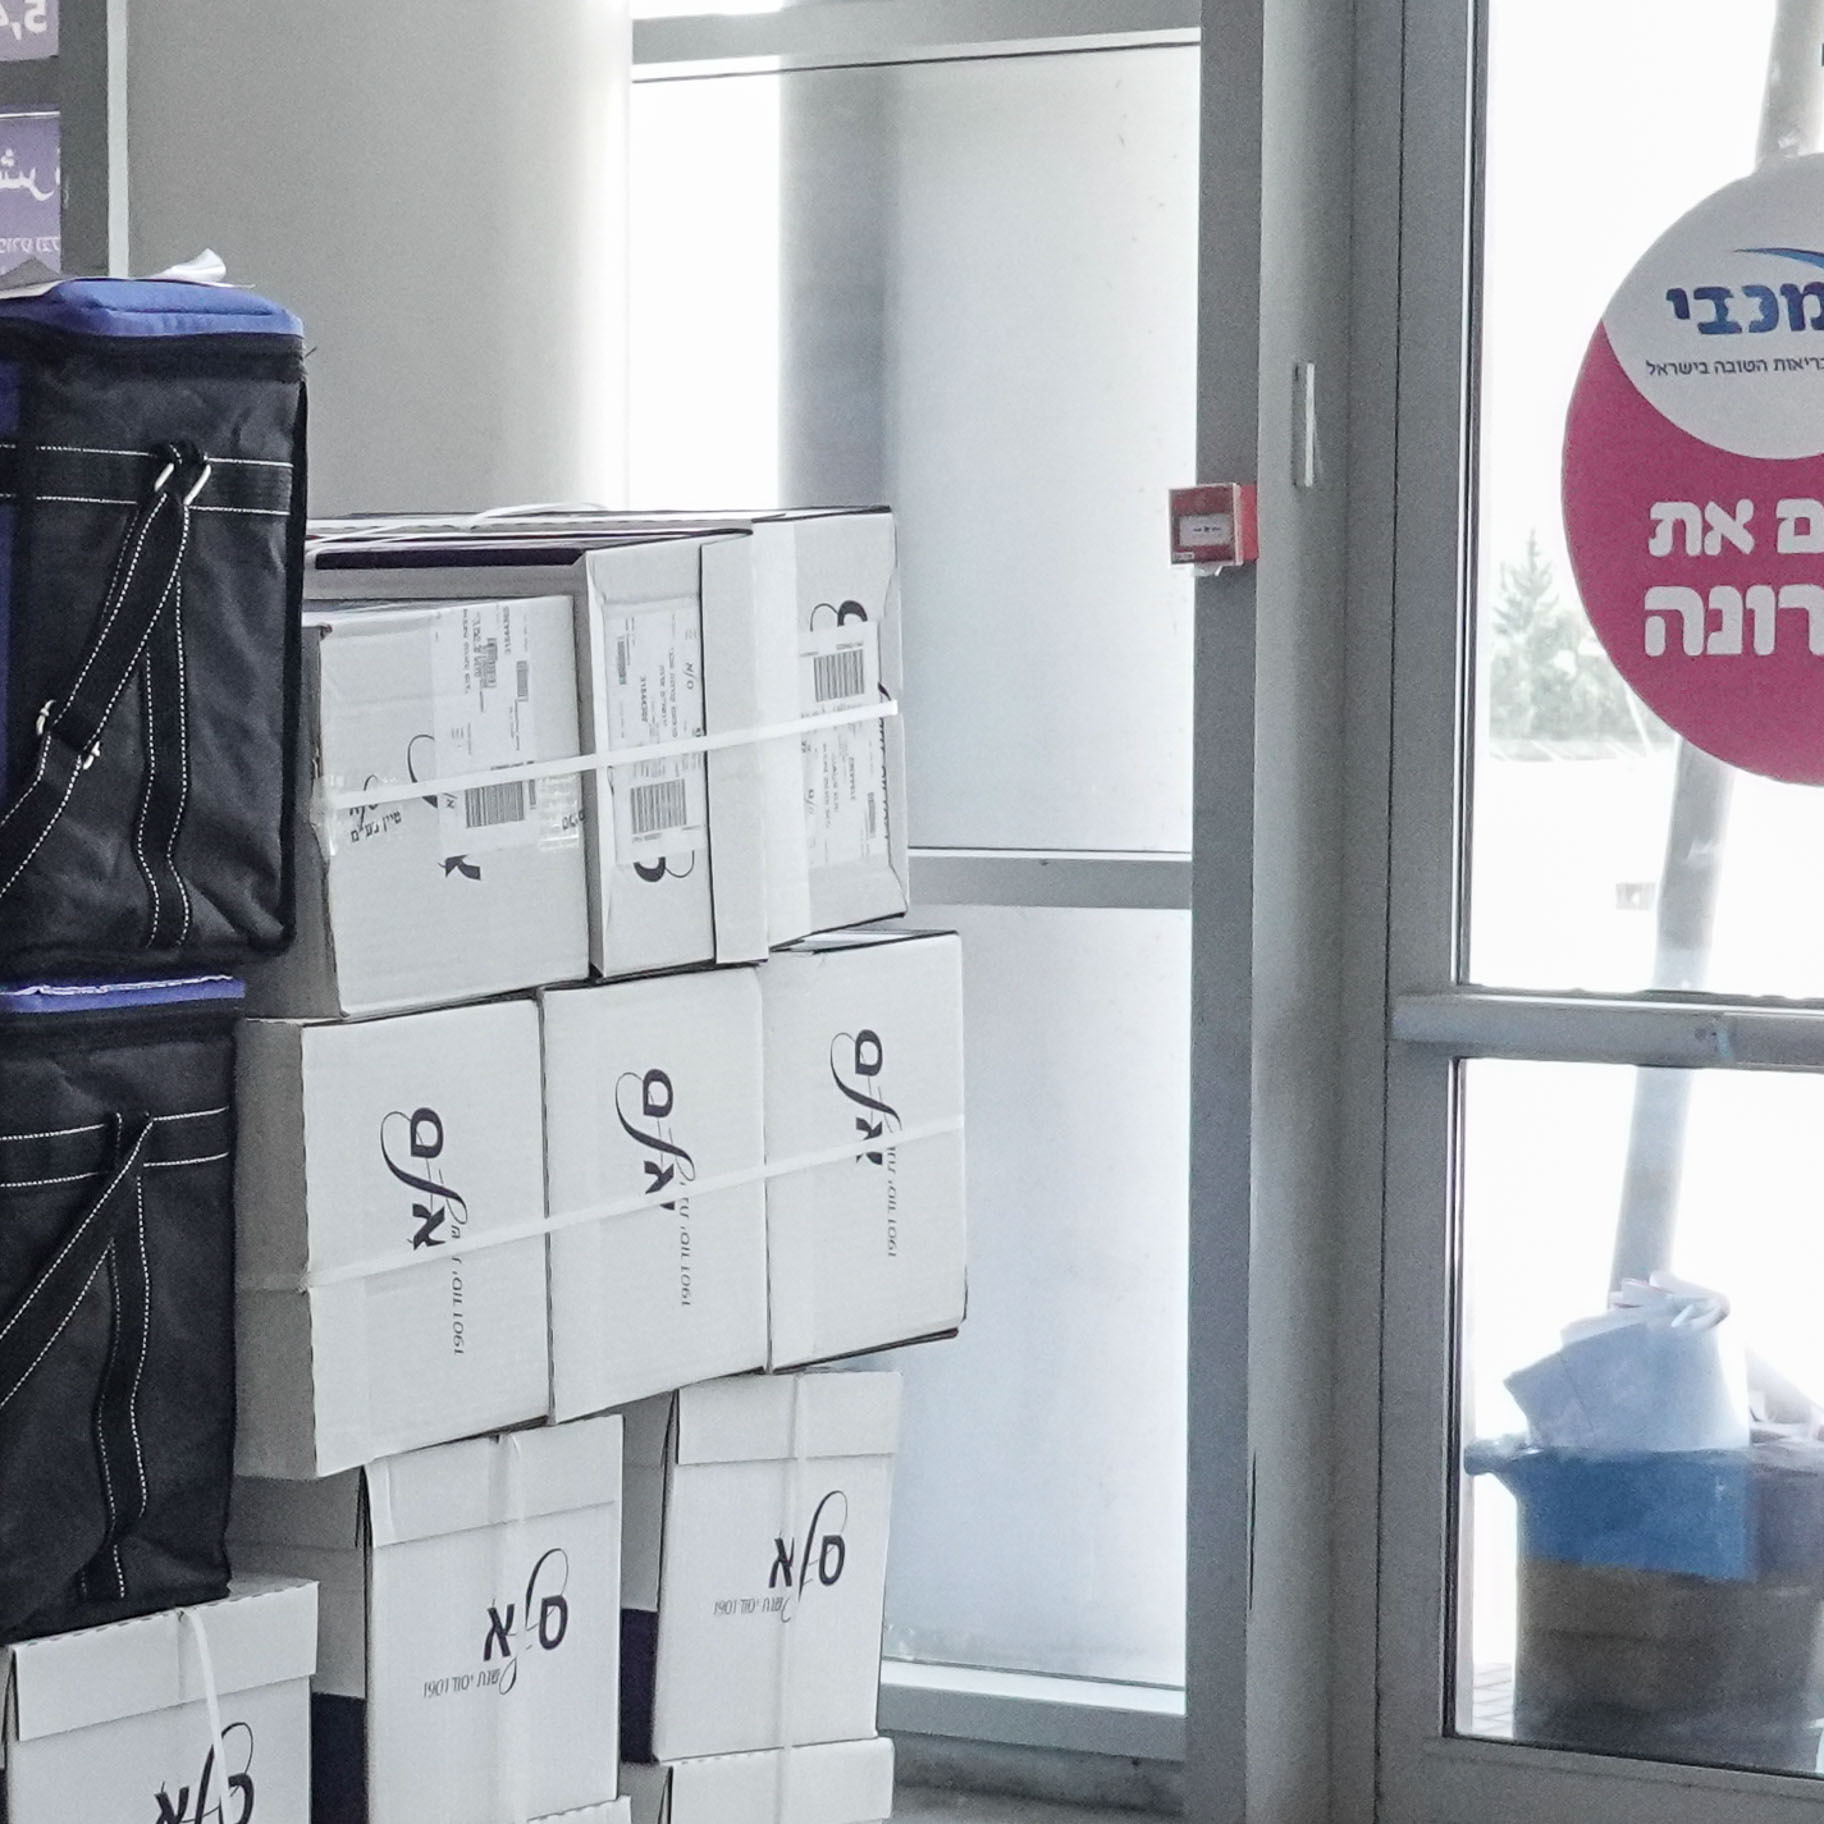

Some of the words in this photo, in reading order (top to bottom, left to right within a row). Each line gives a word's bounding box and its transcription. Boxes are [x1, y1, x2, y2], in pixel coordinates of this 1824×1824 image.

[1645, 360, 1710, 377] בישראל
[1714, 358, 1768, 374] הטובה
[1648, 500, 1755, 557] את
